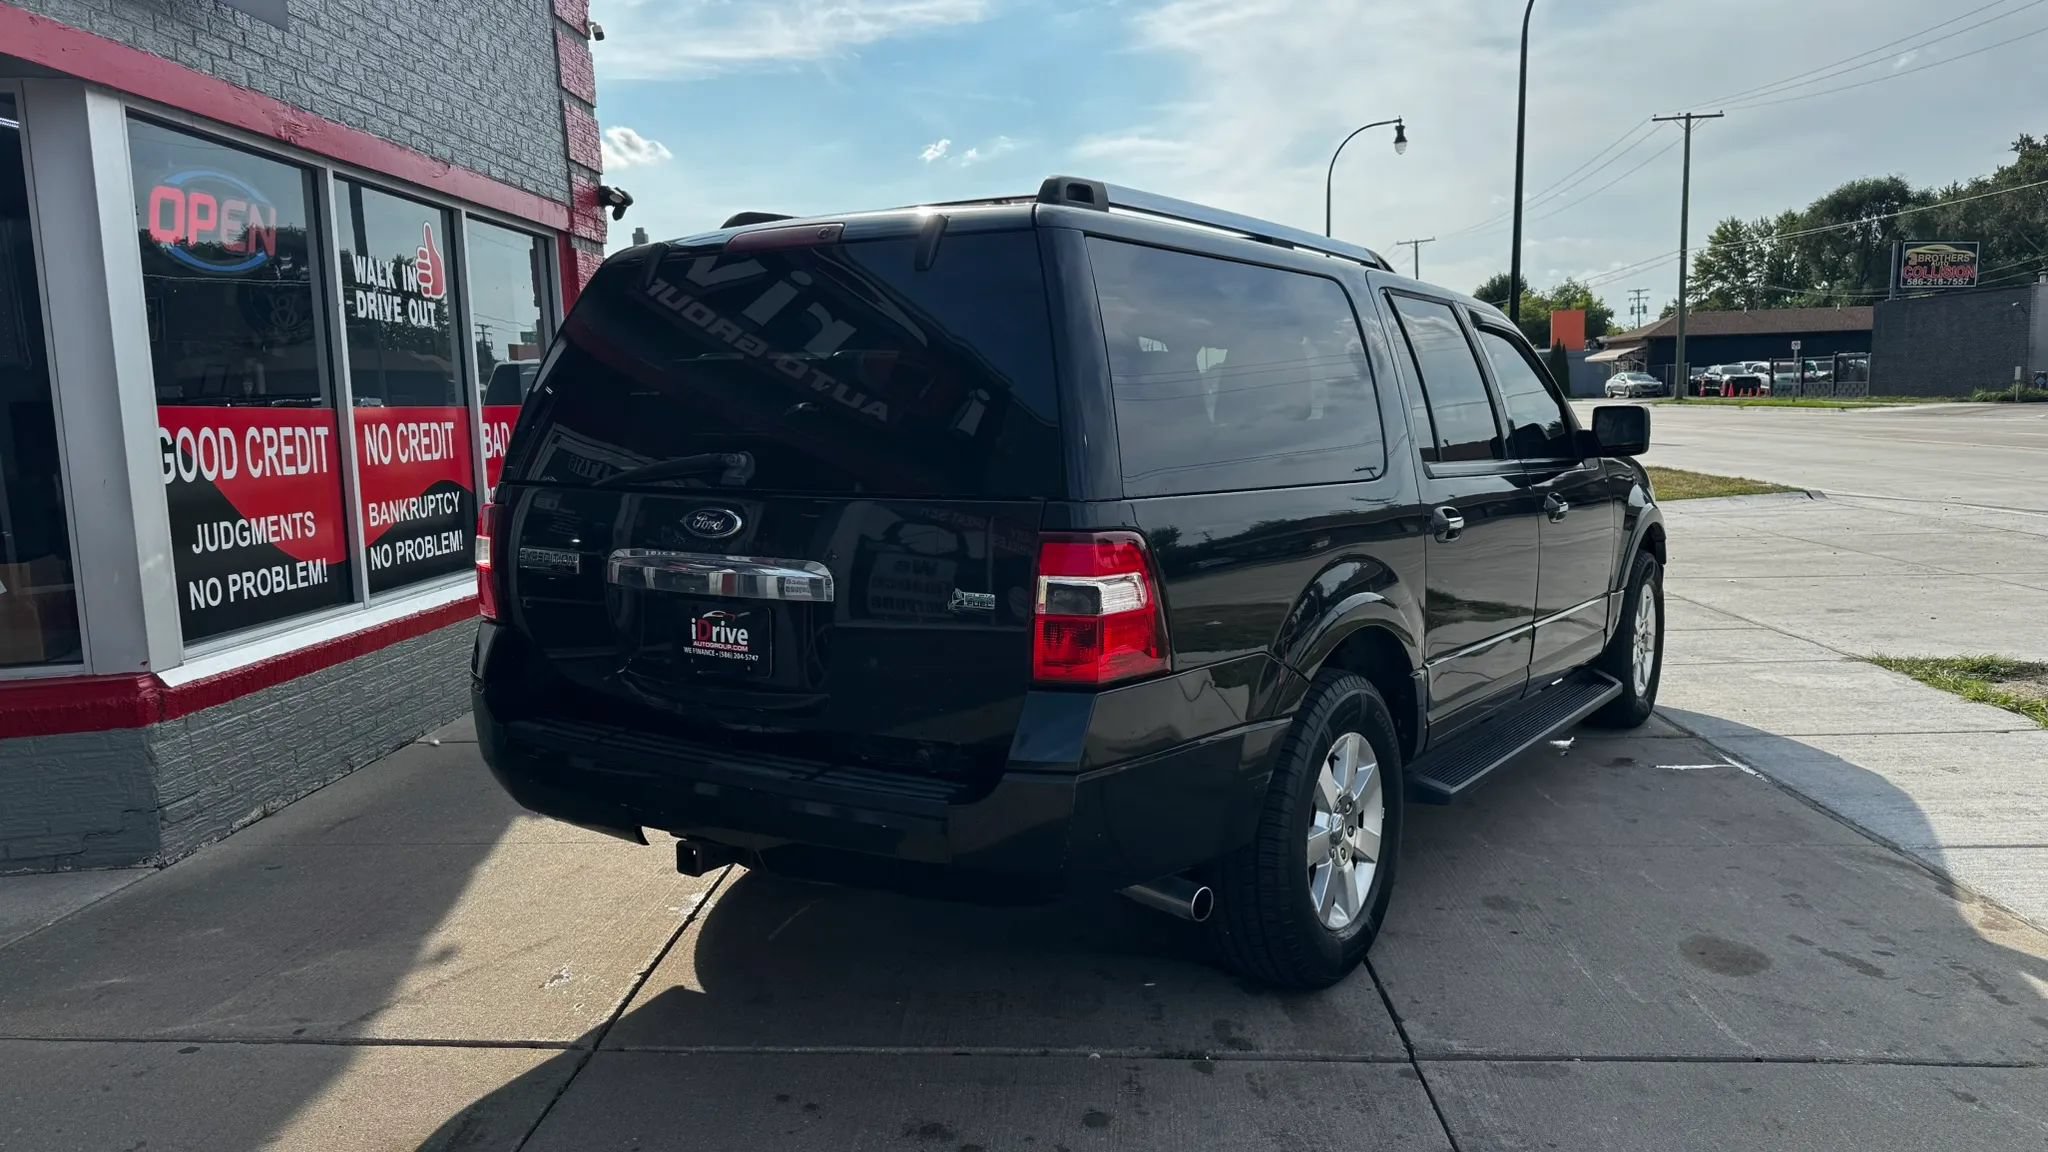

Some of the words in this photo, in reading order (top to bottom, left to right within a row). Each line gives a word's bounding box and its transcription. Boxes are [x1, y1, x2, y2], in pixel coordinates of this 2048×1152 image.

[148, 185, 277, 257] OPEN
[352, 254, 397, 289] WALK
[402, 263, 418, 293] IN
[1903, 265, 1976, 279] COLLISION
[1918, 254, 1970, 262] BROTHERS
[1907, 278, 1969, 286] 586-218-7557
[355, 290, 403, 323] DRIVE
[408, 298, 436, 328] OUT
[159, 426, 238, 485] GOOD
[245, 426, 329, 479] CREDIT
[364, 423, 391, 466] NO
[396, 421, 454, 464] CREDIT
[482, 422, 511, 458] BAD
[369, 491, 460, 527] BANKRUPTCY
[692, 511, 726, 531] Ford
[192, 511, 316, 554] JUDGMENTS
[370, 546, 392, 571] NO
[396, 529, 464, 565] PROBLEM!
[189, 577, 222, 611] NO
[229, 558, 328, 602] PROBLEM!
[691, 618, 749, 645] iDrive
[693, 641, 748, 652] AUTOGROUP.COM
[693, 648, 715, 657] FINANCE
